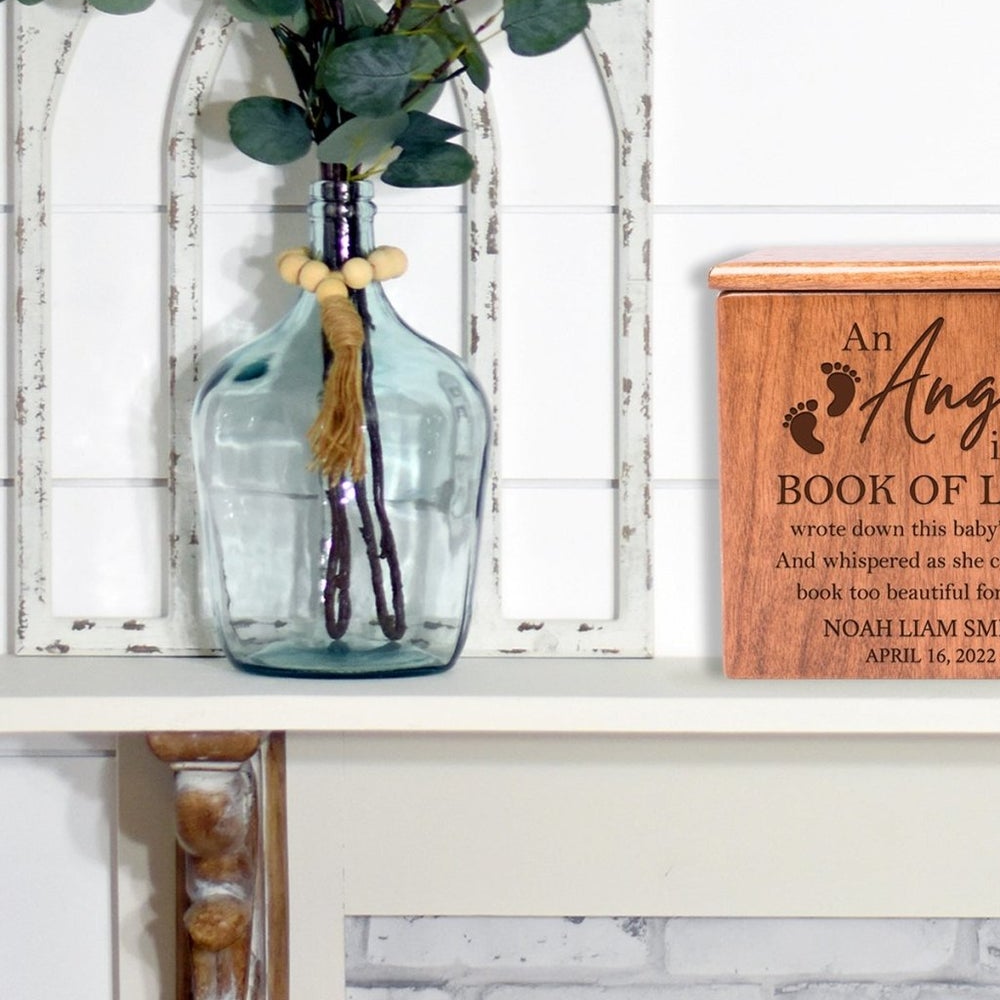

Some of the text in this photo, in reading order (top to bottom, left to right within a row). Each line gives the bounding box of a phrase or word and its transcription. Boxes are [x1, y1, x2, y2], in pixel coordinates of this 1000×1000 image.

[842, 321, 893, 351] An
[776, 474, 897, 506] BOOK
[908, 474, 968, 506] OF
[790, 522, 847, 537] wrote
[851, 520, 905, 537] down
[912, 520, 947, 537] this
[775, 551, 815, 569] And
[823, 551, 920, 574] whispered
[926, 557, 946, 569] as
[952, 551, 984, 569] she
[796, 583, 842, 601] book
[849, 585, 880, 601] too
[886, 583, 969, 601] beautiful
[823, 618, 893, 638] NOAH
[899, 618, 957, 638] LIAM
[865, 648, 996, 666] APRIL 16, 2022
